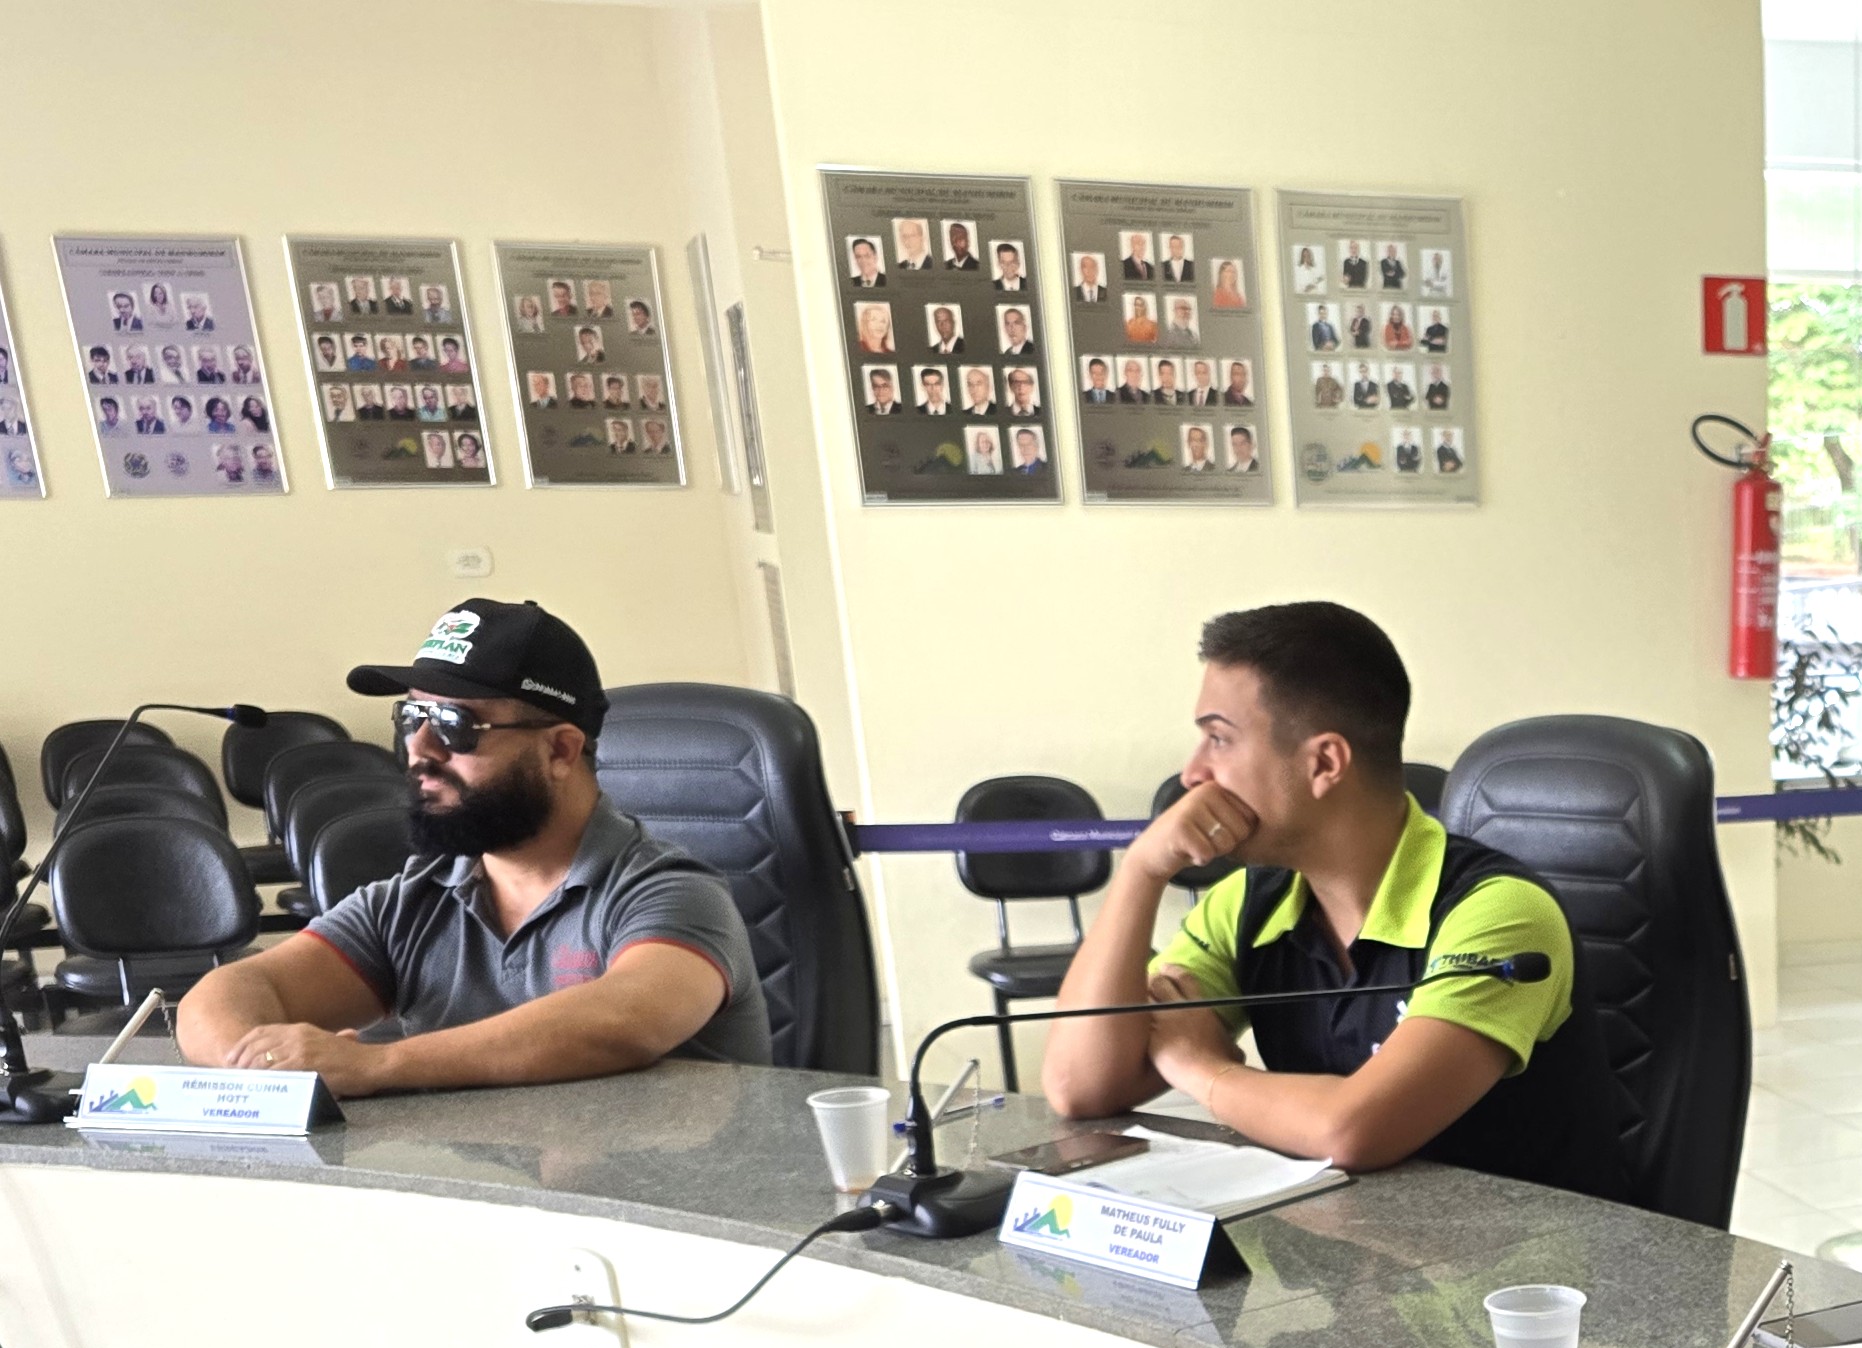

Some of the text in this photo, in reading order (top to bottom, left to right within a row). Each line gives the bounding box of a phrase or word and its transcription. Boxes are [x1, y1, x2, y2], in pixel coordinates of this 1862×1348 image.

[247, 1084, 288, 1093] CUNHA
[203, 1108, 260, 1118] VEREADOR
[1101, 1205, 1186, 1233] MATHEUS FULLY
[1113, 1224, 1163, 1245] DE PAULA
[1109, 1243, 1160, 1264] VEREADOR
